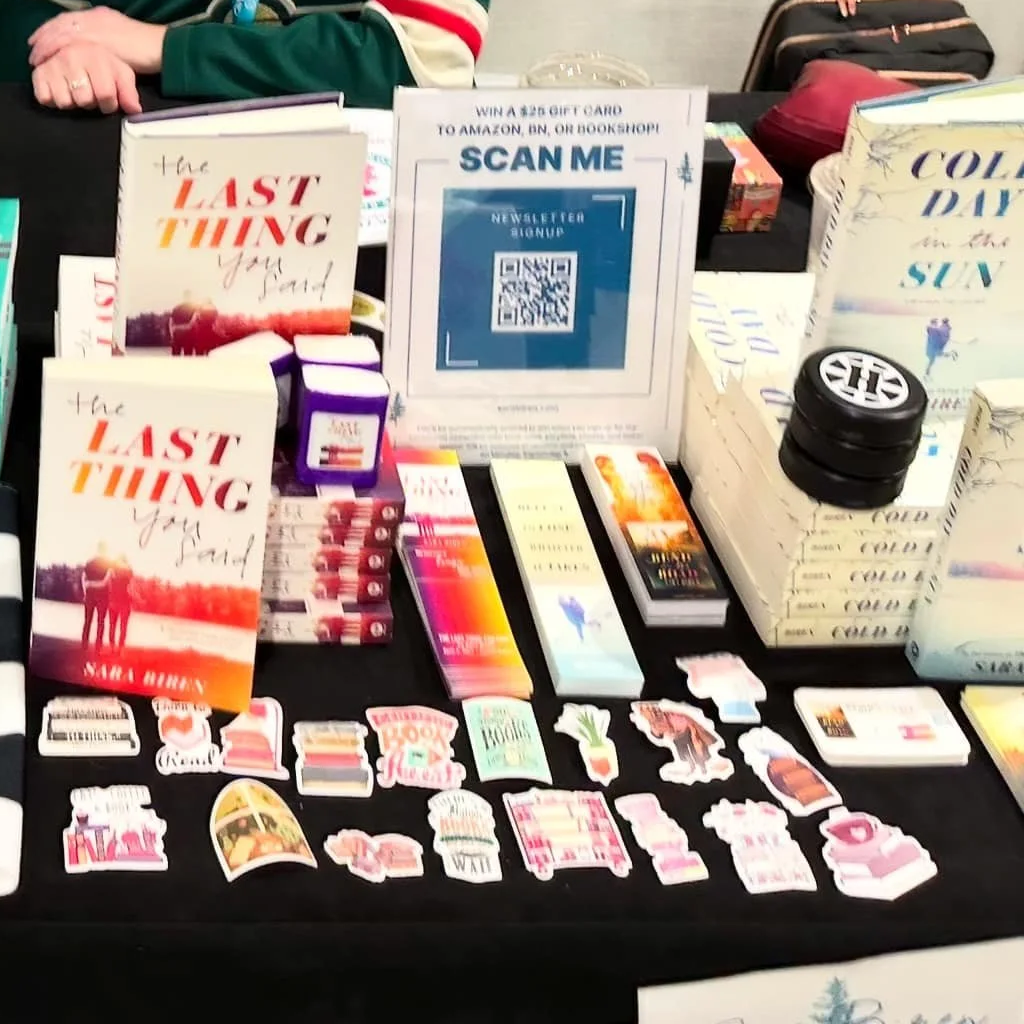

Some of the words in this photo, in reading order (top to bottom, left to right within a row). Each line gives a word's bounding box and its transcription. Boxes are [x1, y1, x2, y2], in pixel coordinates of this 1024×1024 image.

[476, 105, 503, 117] WIN
[507, 105, 516, 117] A
[520, 104, 545, 118] $25
[549, 104, 579, 117] GIFT
[583, 104, 623, 117] CARD
[437, 124, 455, 136] TO
[459, 123, 525, 138] AMAZON,
[554, 122, 574, 136] OR
[459, 146, 563, 172] SCAN
[570, 145, 624, 171] ME
[173, 175, 321, 211] LAST
[921, 188, 1024, 217] DAY
[156, 212, 332, 249] THING
[491, 212, 585, 226] NEWSLETTER
[900, 261, 1006, 289] SUN
[87, 419, 241, 467] LAST
[69, 460, 253, 514] THING
[872, 510, 929, 524] COLD
[860, 541, 917, 554] COLD
[832, 625, 887, 638] COLD
[83, 661, 136, 685] SARA
